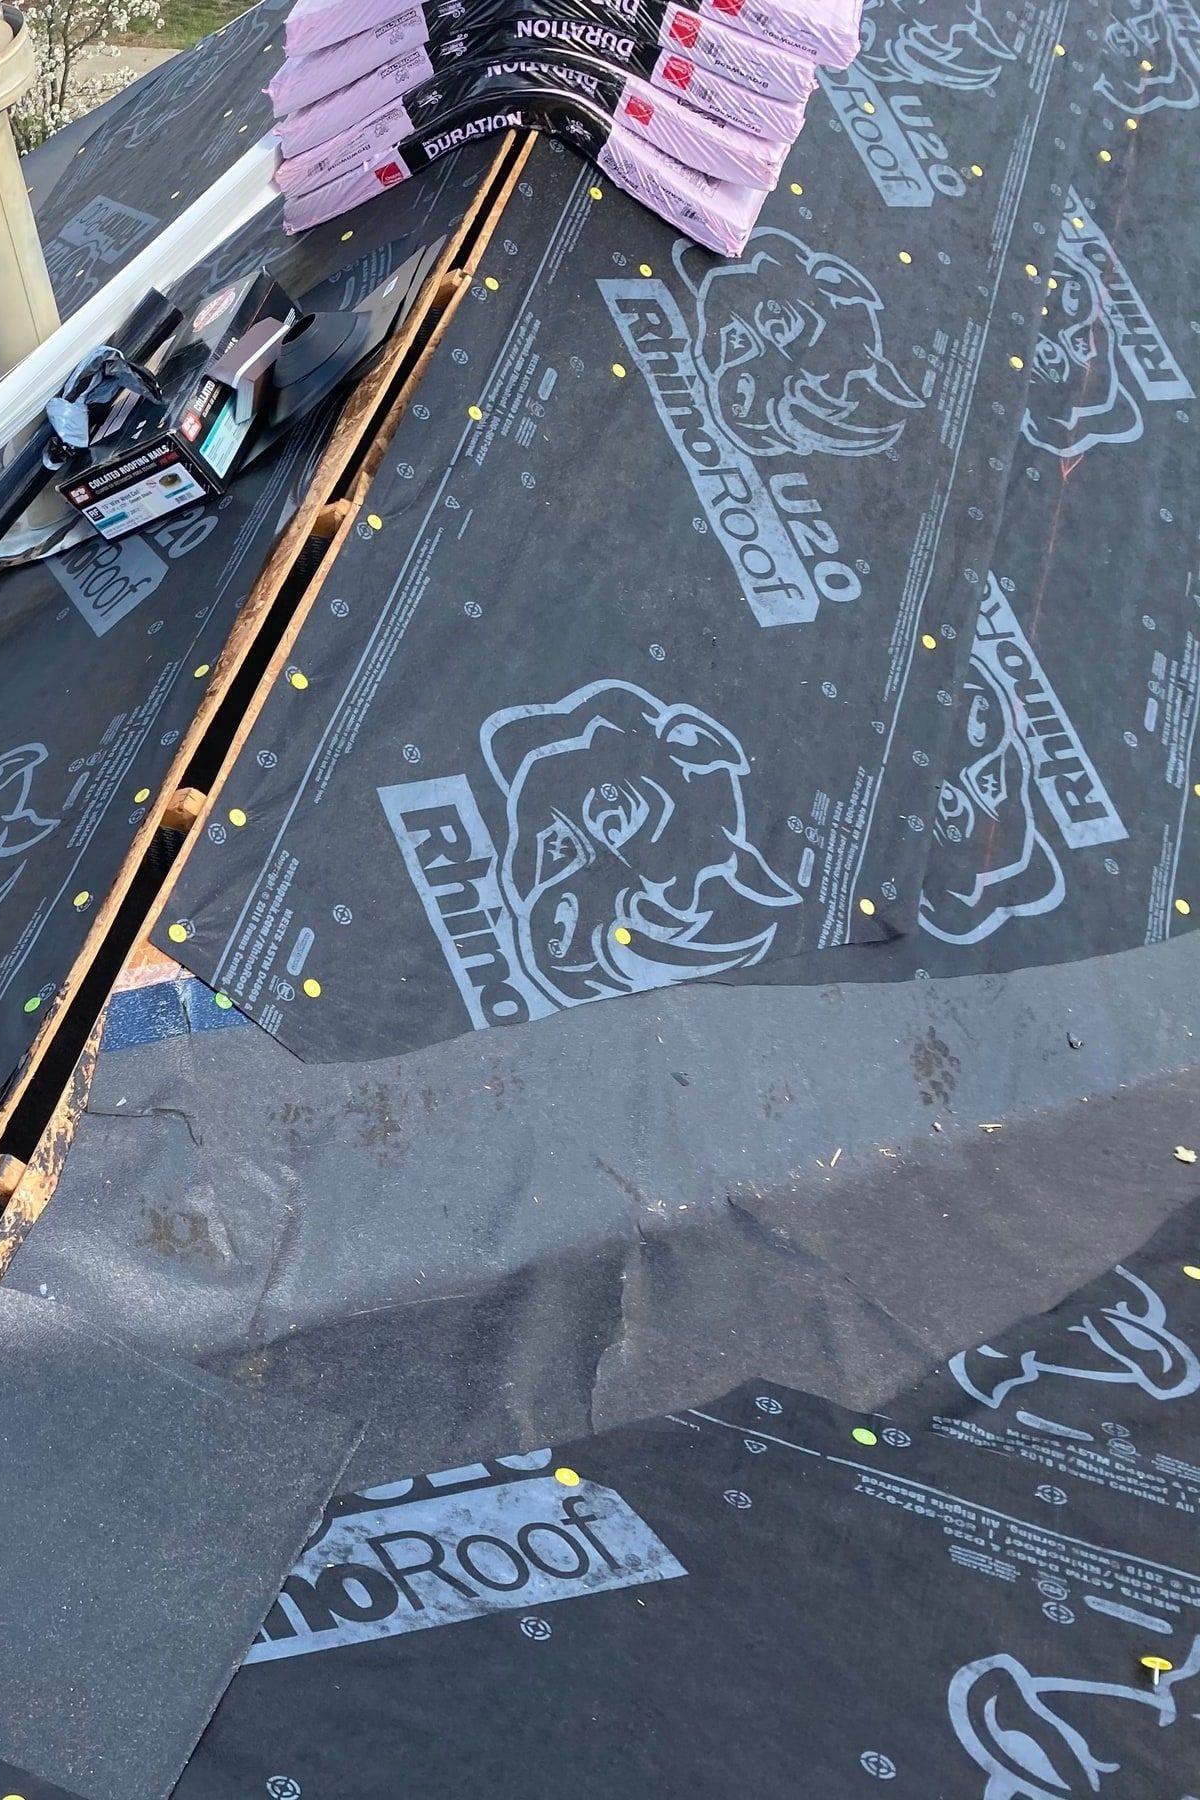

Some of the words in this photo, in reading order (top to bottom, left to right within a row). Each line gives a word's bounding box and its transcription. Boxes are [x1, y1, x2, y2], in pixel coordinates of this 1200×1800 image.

[516, 19, 636, 59] DURATION
[423, 110, 523, 160] DURATION
[888, 95, 968, 197] U20
[191, 381, 215, 412] COLLATED
[88, 470, 121, 489] COLLATED
[119, 456, 149, 474] ROOFING
[147, 445, 170, 460] NAILS
[615, 298, 805, 601] RhinoRoof
[768, 471, 863, 603] U20
[266, 850, 290, 891] Copyright
[274, 908, 293, 942] MEETS
[261, 942, 278, 971] ASTM
[1020, 1449, 1053, 1467] 2018
[1067, 1445, 1110, 1466] ASTM
[981, 1516, 1000, 1528] All
[1066, 1569, 1114, 1589] ASTM
